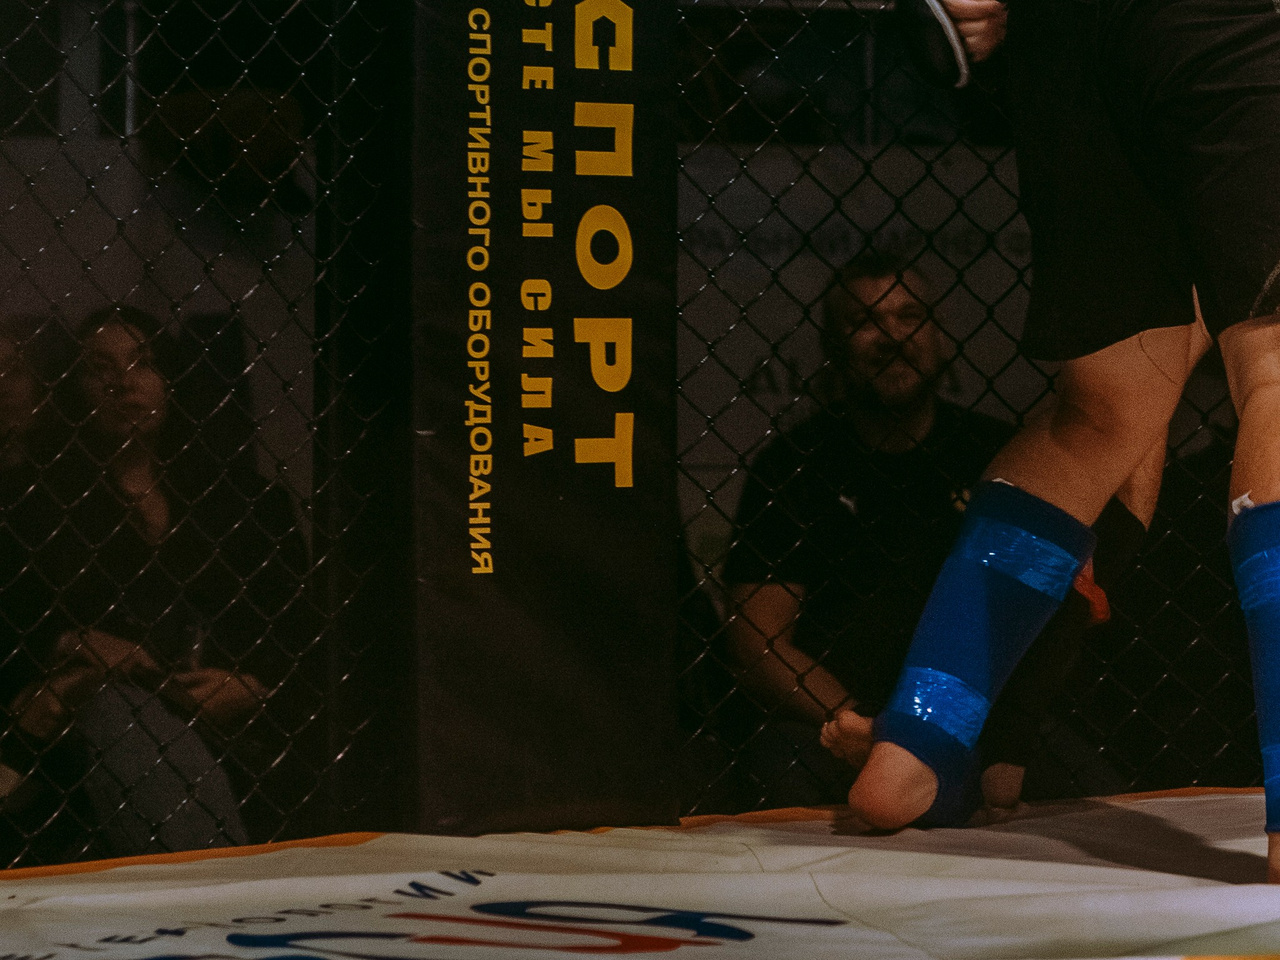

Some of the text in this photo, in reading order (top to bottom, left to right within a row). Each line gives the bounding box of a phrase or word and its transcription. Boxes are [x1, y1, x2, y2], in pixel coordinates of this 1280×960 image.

[466, 7, 492, 272] СПОРТИВНОГО
[520, 130, 554, 237] МЫ
[464, 281, 494, 575] ОБОРУДОВАНИЯ
[520, 278, 554, 457] СИЛА
